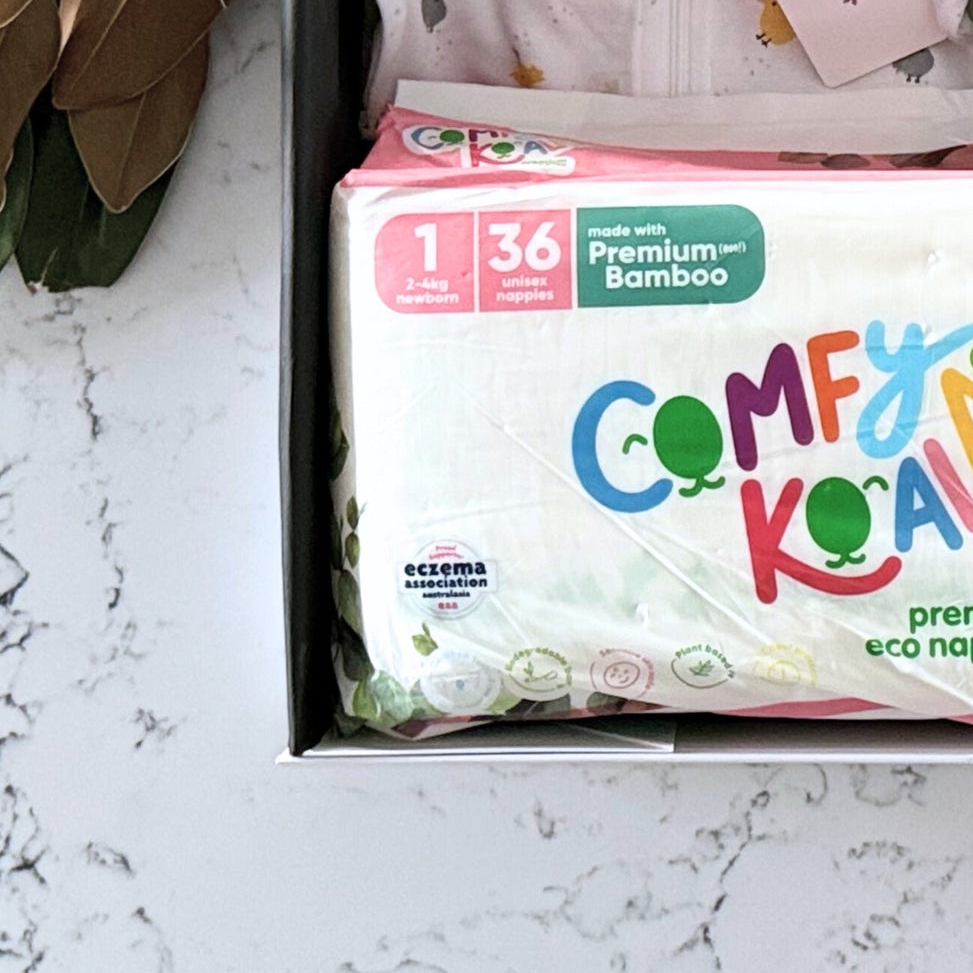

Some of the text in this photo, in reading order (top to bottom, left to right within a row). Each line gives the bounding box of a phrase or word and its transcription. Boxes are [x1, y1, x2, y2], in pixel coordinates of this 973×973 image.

[588, 222, 667, 238] made with
[414, 223, 437, 272] 1
[488, 221, 562, 273] 36
[589, 238, 718, 265] Premium
[502, 274, 548, 288] unisex
[605, 263, 729, 289] Bamboo
[406, 277, 449, 292] 2-4kg
[396, 291, 460, 305] newborn
[496, 288, 554, 305] nappies
[404, 561, 487, 577] eczema
[404, 574, 488, 589] association
[675, 643, 703, 659] Plant
[865, 638, 921, 659] eco
